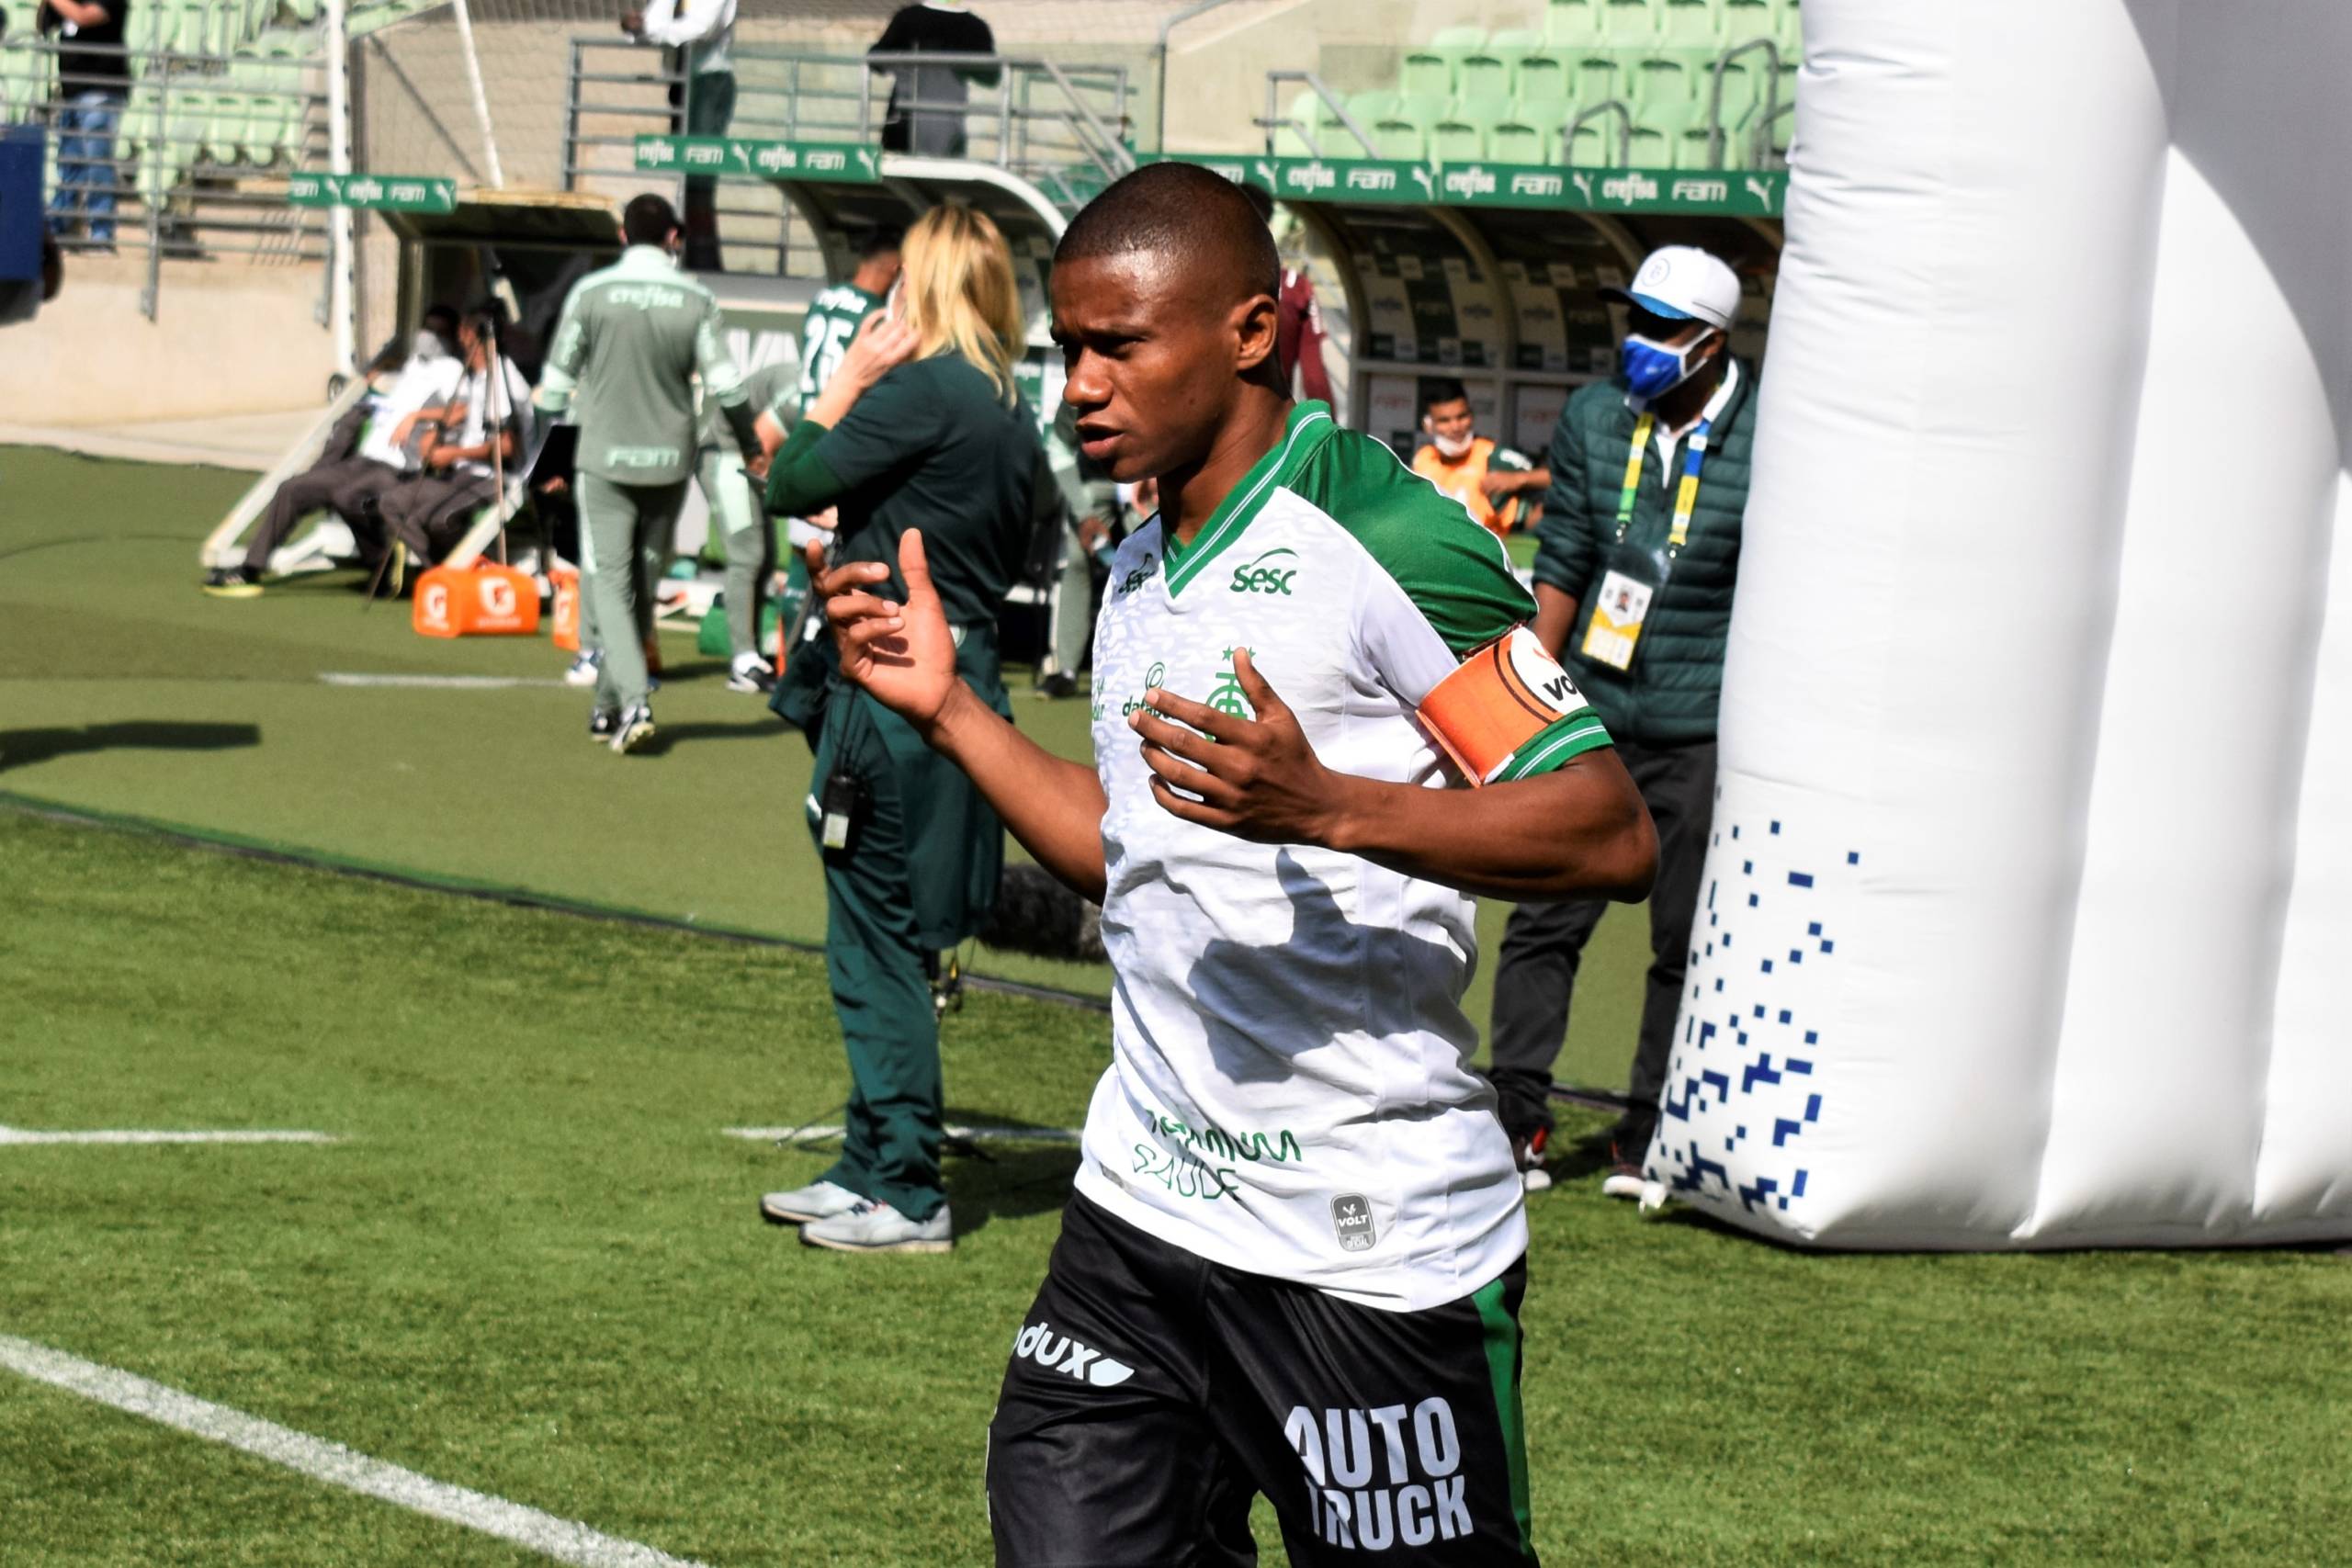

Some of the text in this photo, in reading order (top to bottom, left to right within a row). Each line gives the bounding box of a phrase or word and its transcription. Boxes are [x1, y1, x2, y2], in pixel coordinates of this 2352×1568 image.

[1229, 564, 1297, 596] sesc
[1338, 1214, 1367, 1227] VOLT
[1013, 1321, 1102, 1381] dux
[1284, 1396, 1461, 1488] AUTO
